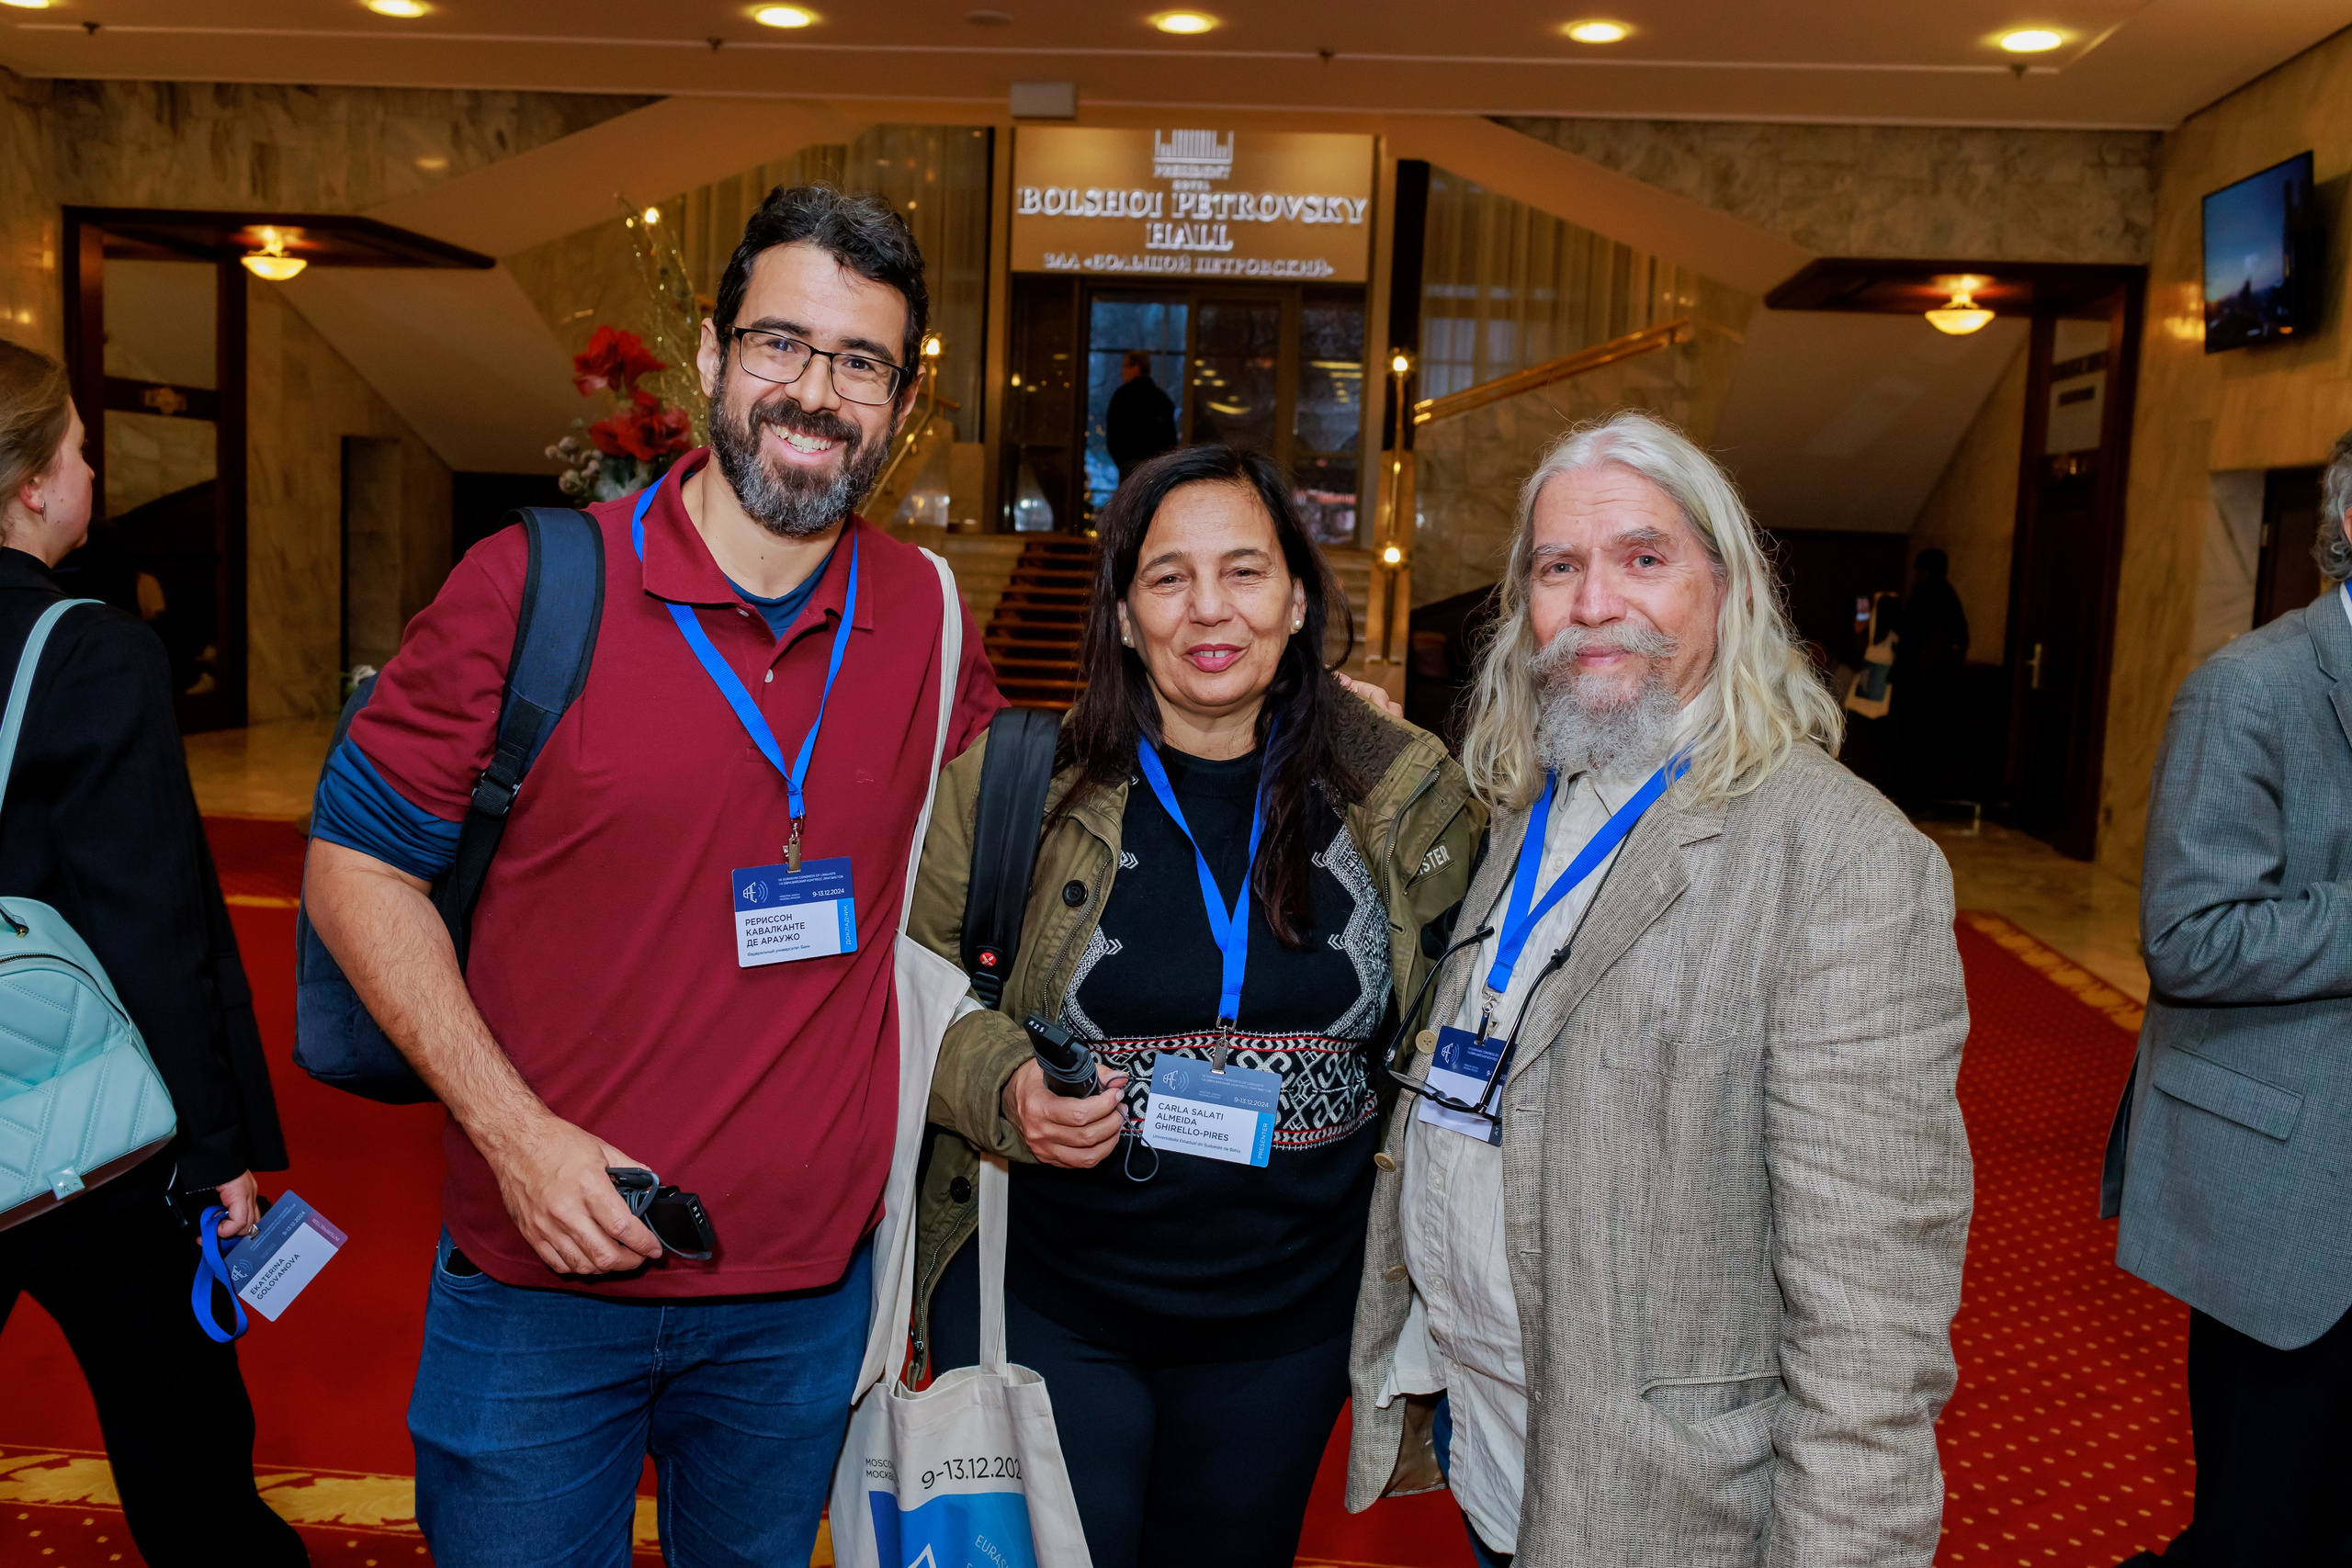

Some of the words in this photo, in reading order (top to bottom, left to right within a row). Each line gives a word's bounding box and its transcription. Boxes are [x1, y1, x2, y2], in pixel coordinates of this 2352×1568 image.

[1017, 187, 1163, 219] BOLSHOI
[1171, 192, 1367, 224] PETROVSKY
[1146, 222, 1233, 252] HALL
[812, 887, 845, 897] 9-13.12.2024
[745, 913, 793, 927] РЕРИССОН
[746, 921, 806, 937] КАВАЛКАНТЕ
[842, 905, 852, 945] ДОКЛАДЧИК
[746, 938, 759, 948] ДЕ
[761, 932, 800, 946] АРАУЖО
[1158, 1102, 1189, 1114] CARLA
[1192, 1108, 1224, 1121] SALATI
[1234, 1096, 1269, 1108] 9-13.12.2024
[1156, 1112, 1197, 1126] ALMEIDA
[1153, 1134, 1180, 1143] Universidade
[1155, 1122, 1229, 1142] GHIRELLO-PIRES
[1258, 1122, 1268, 1159] PRESENTER
[250, 1258, 286, 1296] EKATERINA
[256, 1253, 301, 1301] GOLOVANOVA
[865, 1458, 892, 1469] MOSCO
[922, 1456, 1022, 1490] 9-13.12.202
[865, 1470, 895, 1482] МОСКВ
[975, 1534, 1010, 1568] EURAS
